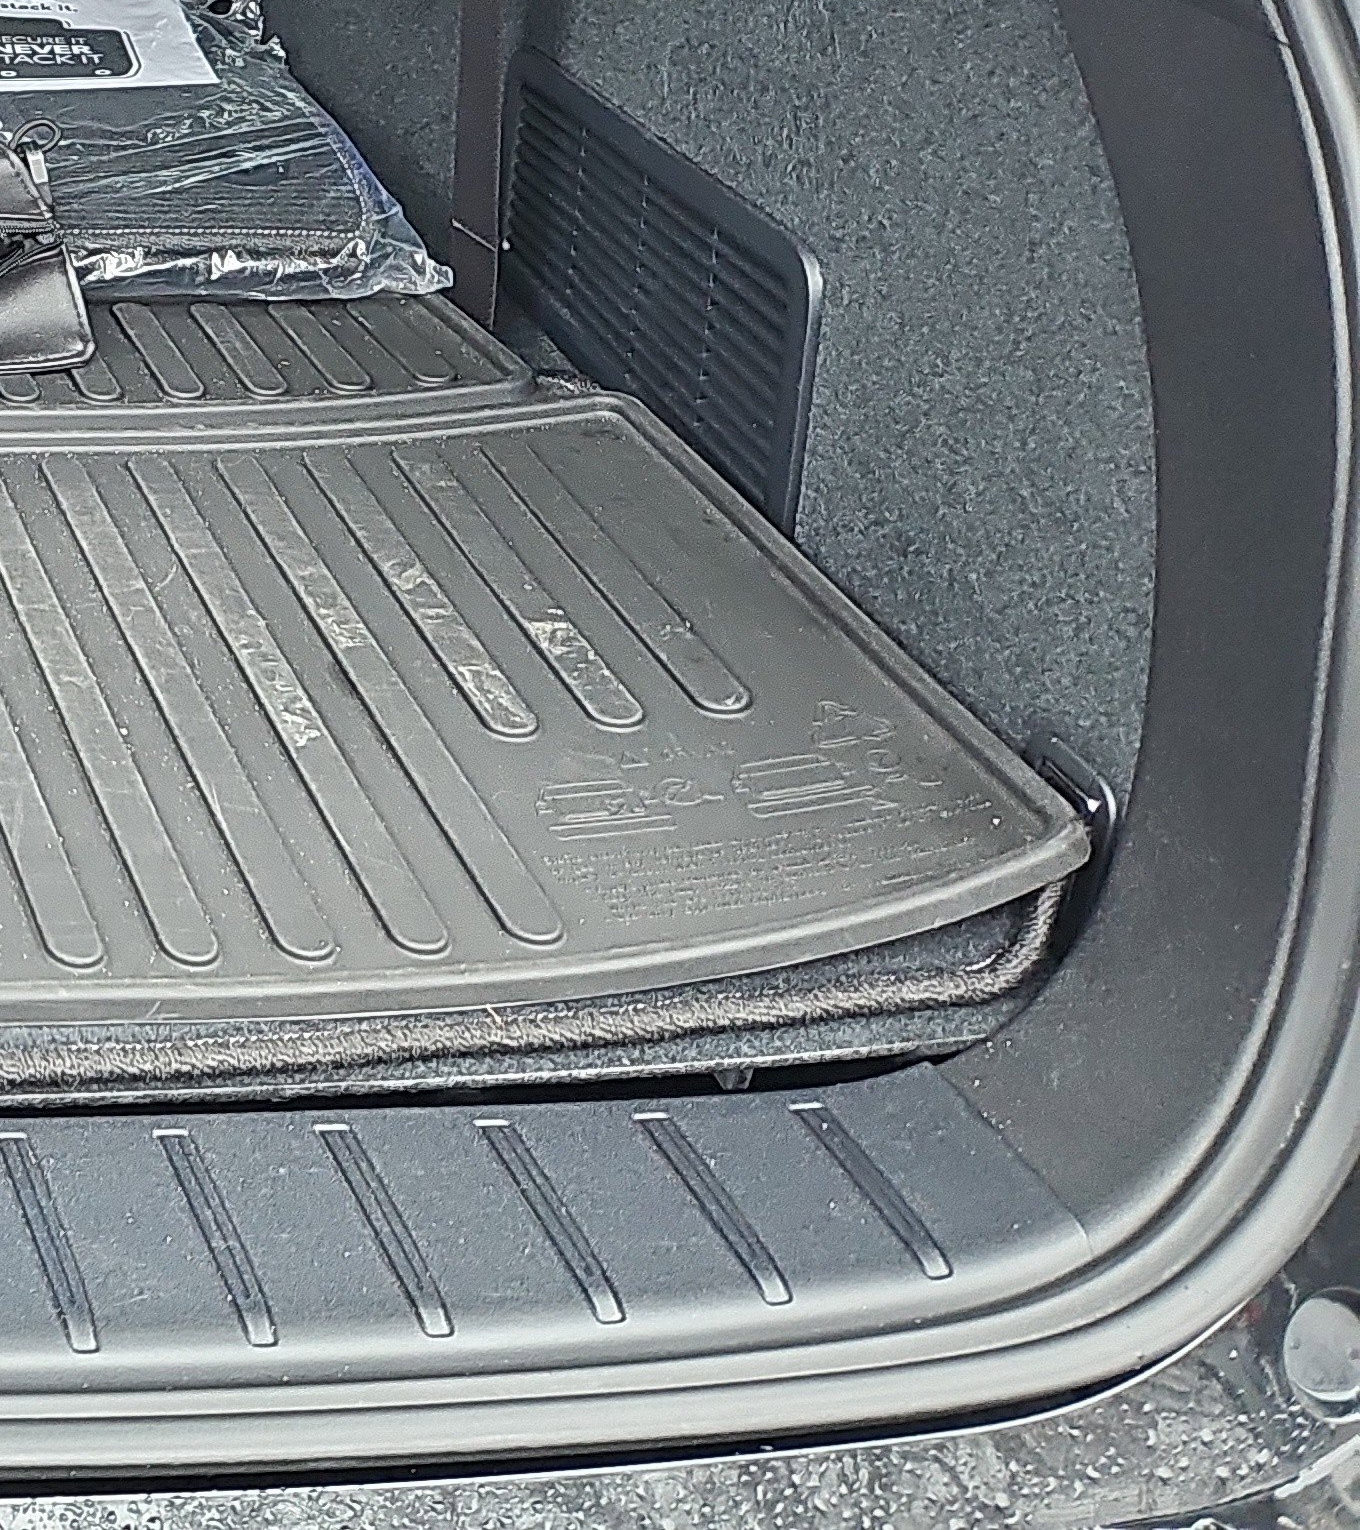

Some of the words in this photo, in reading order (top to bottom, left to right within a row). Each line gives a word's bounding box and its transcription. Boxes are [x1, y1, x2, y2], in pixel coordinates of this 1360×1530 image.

[0, 1, 53, 13] stack
[70, 36, 89, 46] IT
[81, 54, 105, 66] IT
